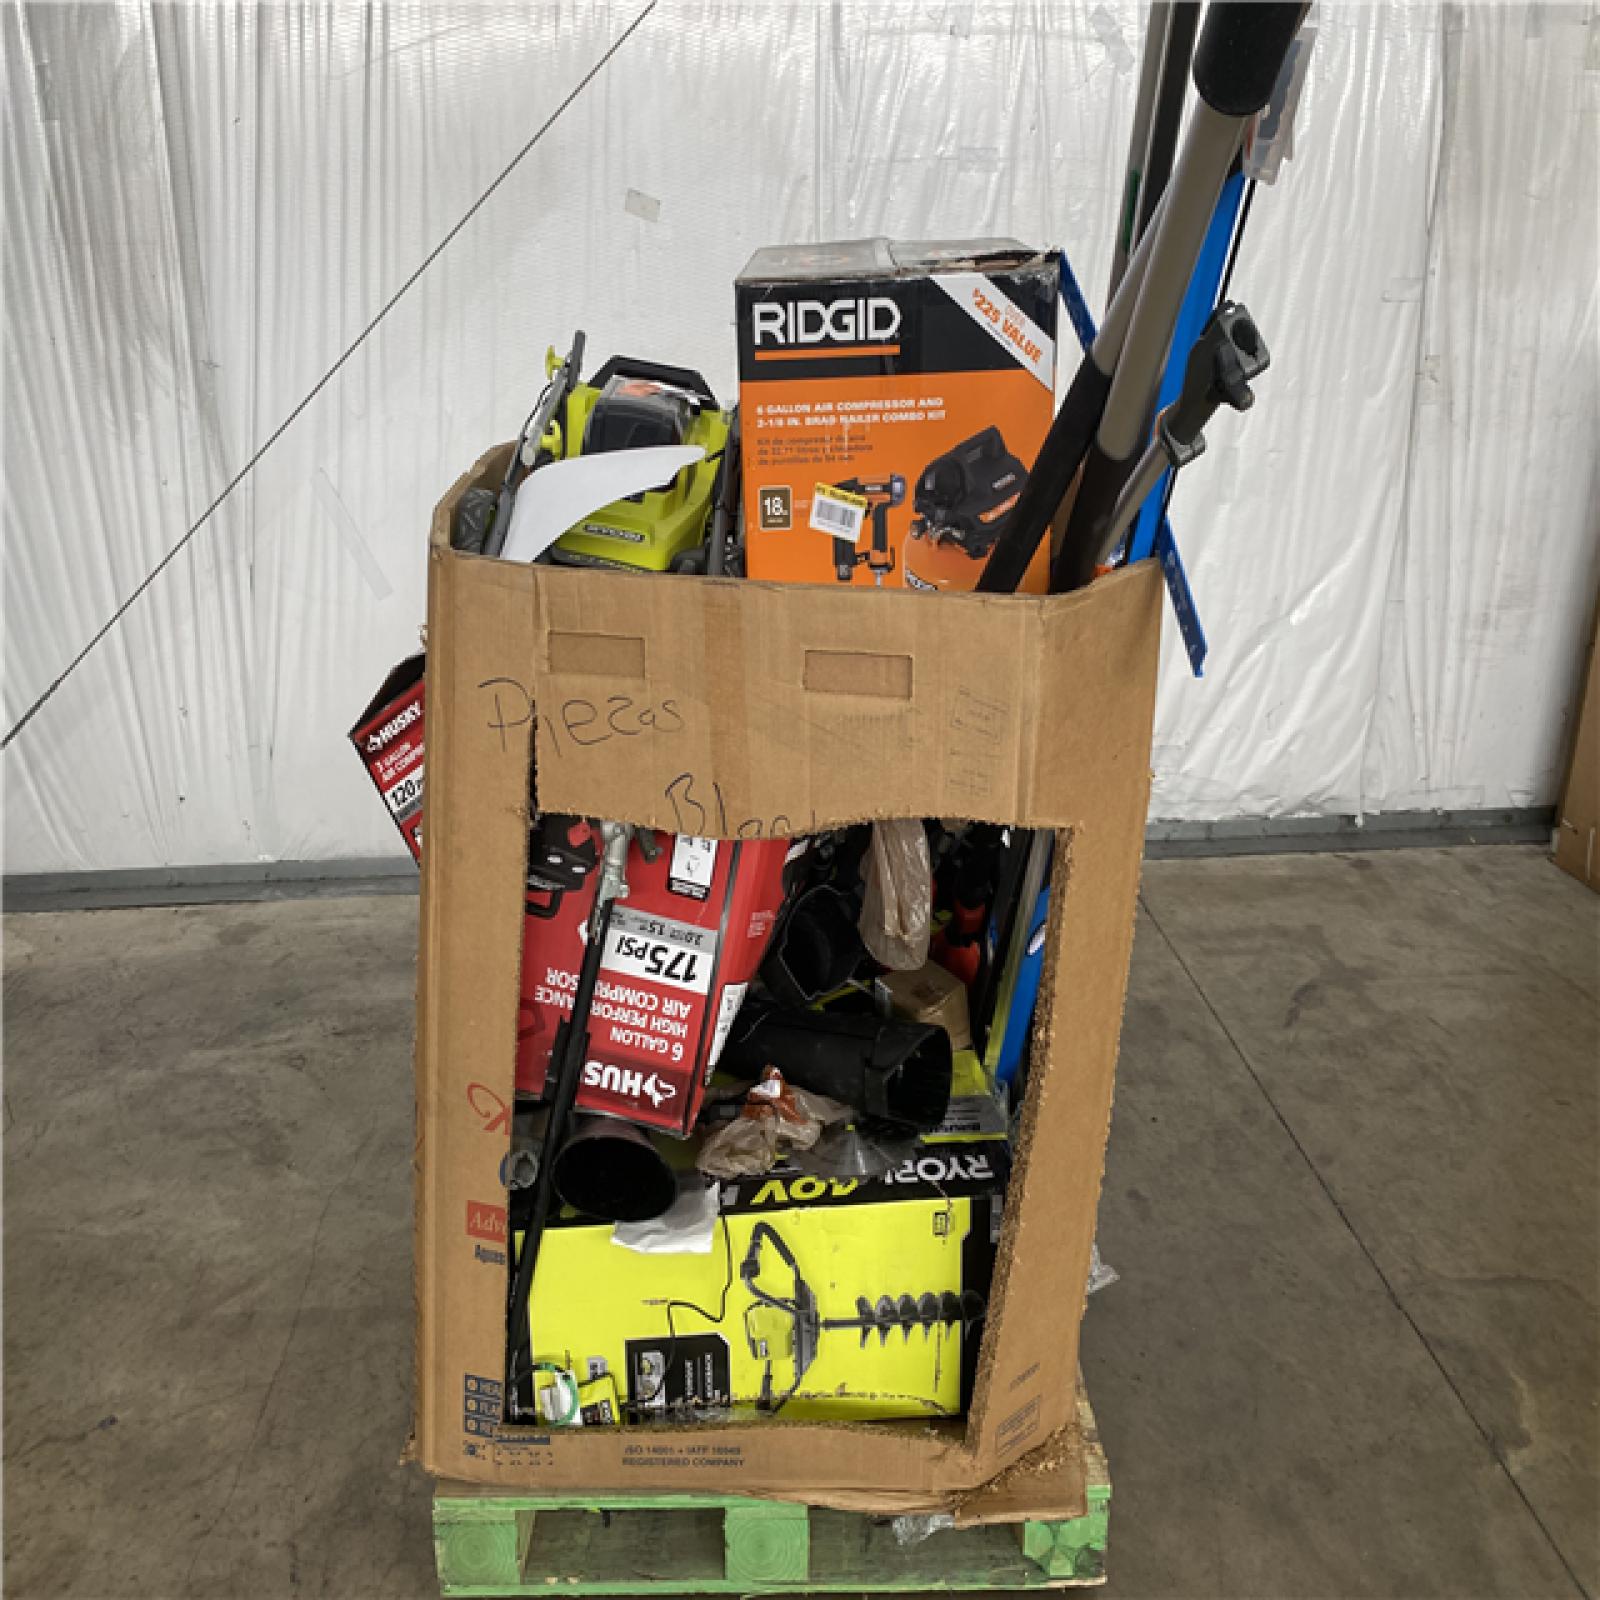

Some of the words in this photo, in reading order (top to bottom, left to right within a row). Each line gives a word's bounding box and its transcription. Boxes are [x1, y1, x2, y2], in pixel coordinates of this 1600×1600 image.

[752, 298, 901, 345] RIDGID
[1002, 319, 1042, 363] VALUE
[767, 404, 811, 415] GALLON
[814, 402, 834, 412] AIR
[837, 399, 916, 412] COMPRESSOR
[918, 397, 944, 407] AND
[804, 414, 836, 426] BRAD
[882, 412, 926, 423] COMBO
[764, 496, 783, 516] 18
[379, 701, 421, 743] HUSKY
[662, 998, 692, 1018] AIR
[651, 1012, 689, 1039] HIGH
[609, 1026, 669, 1053] GALLON
[671, 1042, 684, 1061] 6
[583, 1060, 642, 1097] HUS
[692, 1457, 746, 1468] COMPANY
